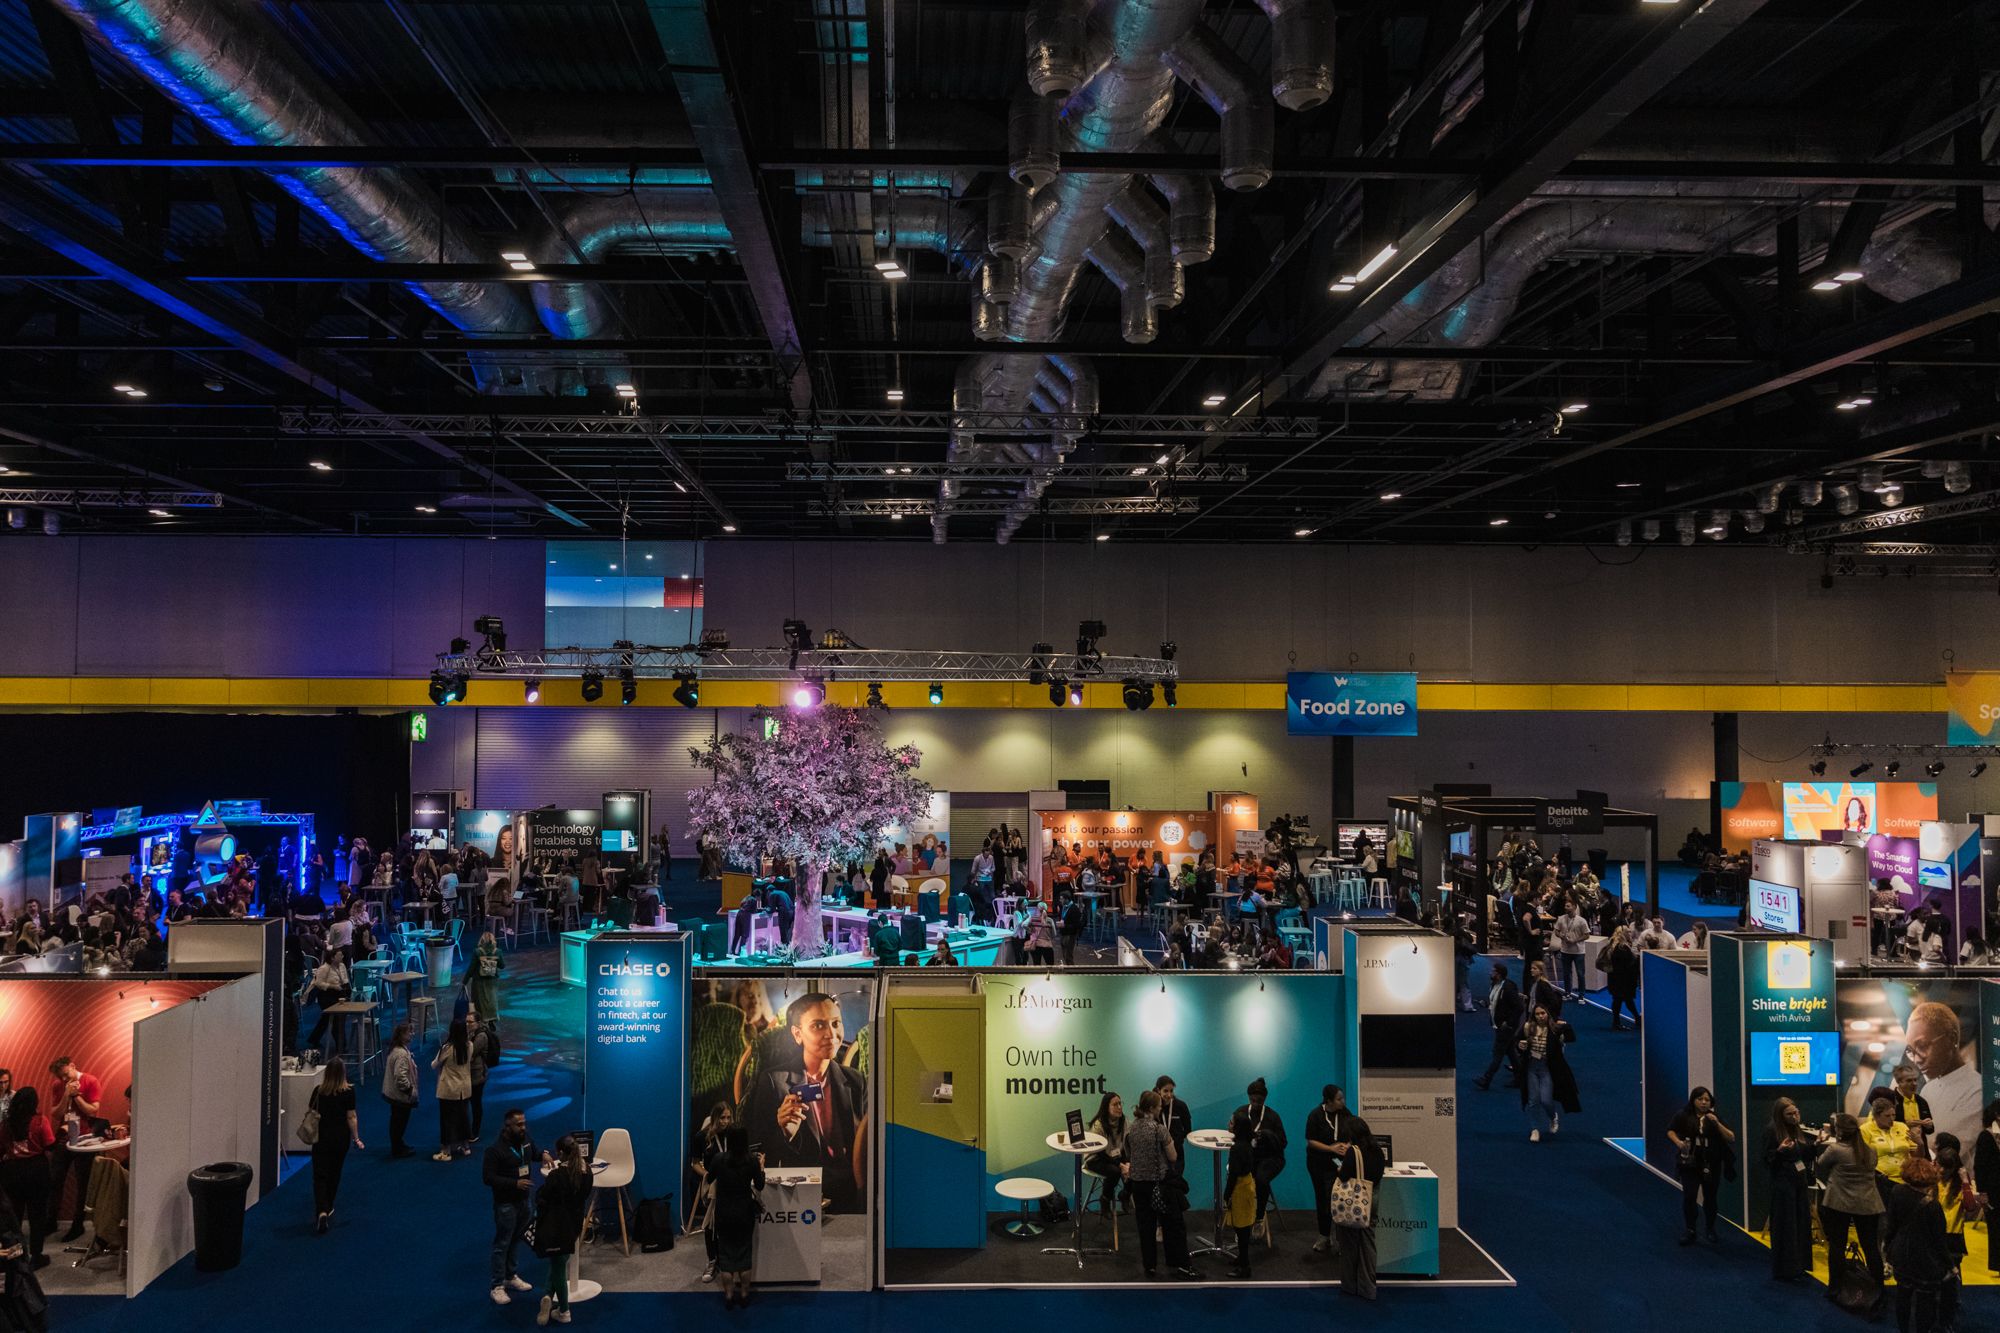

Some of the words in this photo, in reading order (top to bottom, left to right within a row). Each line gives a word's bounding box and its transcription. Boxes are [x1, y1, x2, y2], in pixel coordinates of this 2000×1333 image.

[1300, 699, 1350, 715] Food
[1355, 699, 1405, 715] Zone
[1548, 816, 1574, 828] Digital
[1728, 818, 1777, 828] Software
[1884, 818, 1920, 828] Softwa
[534, 824, 596, 836] Technology
[1070, 825, 1078, 833] is
[1102, 825, 1143, 835] passion
[534, 836, 576, 845] enables
[1112, 840, 1156, 848] power
[534, 848, 578, 856] inovte
[1873, 850, 1885, 860] The
[1886, 852, 1911, 863] Smarter
[1872, 861, 1885, 871] Way
[1887, 862, 1894, 871] to
[1894, 864, 1912, 875] Cloud
[1760, 891, 1787, 910] 1541
[1764, 912, 1784, 924] Stores
[599, 964, 654, 976] CHASE
[598, 987, 617, 996] Chat
[598, 1000, 623, 1008] about
[1752, 998, 1787, 1010] Shine
[1789, 996, 1828, 1014] bright
[598, 1011, 606, 1019] in
[608, 1011, 640, 1020] fintech,
[1768, 1013, 1787, 1022] with
[1789, 1014, 1811, 1022] Aviva
[598, 1023, 660, 1033] award-winning
[598, 1035, 623, 1044] digital
[1006, 1046, 1052, 1066] Own
[1062, 1045, 1097, 1066] the
[1006, 1074, 1107, 1094] moment
[755, 1211, 797, 1223] HASE
